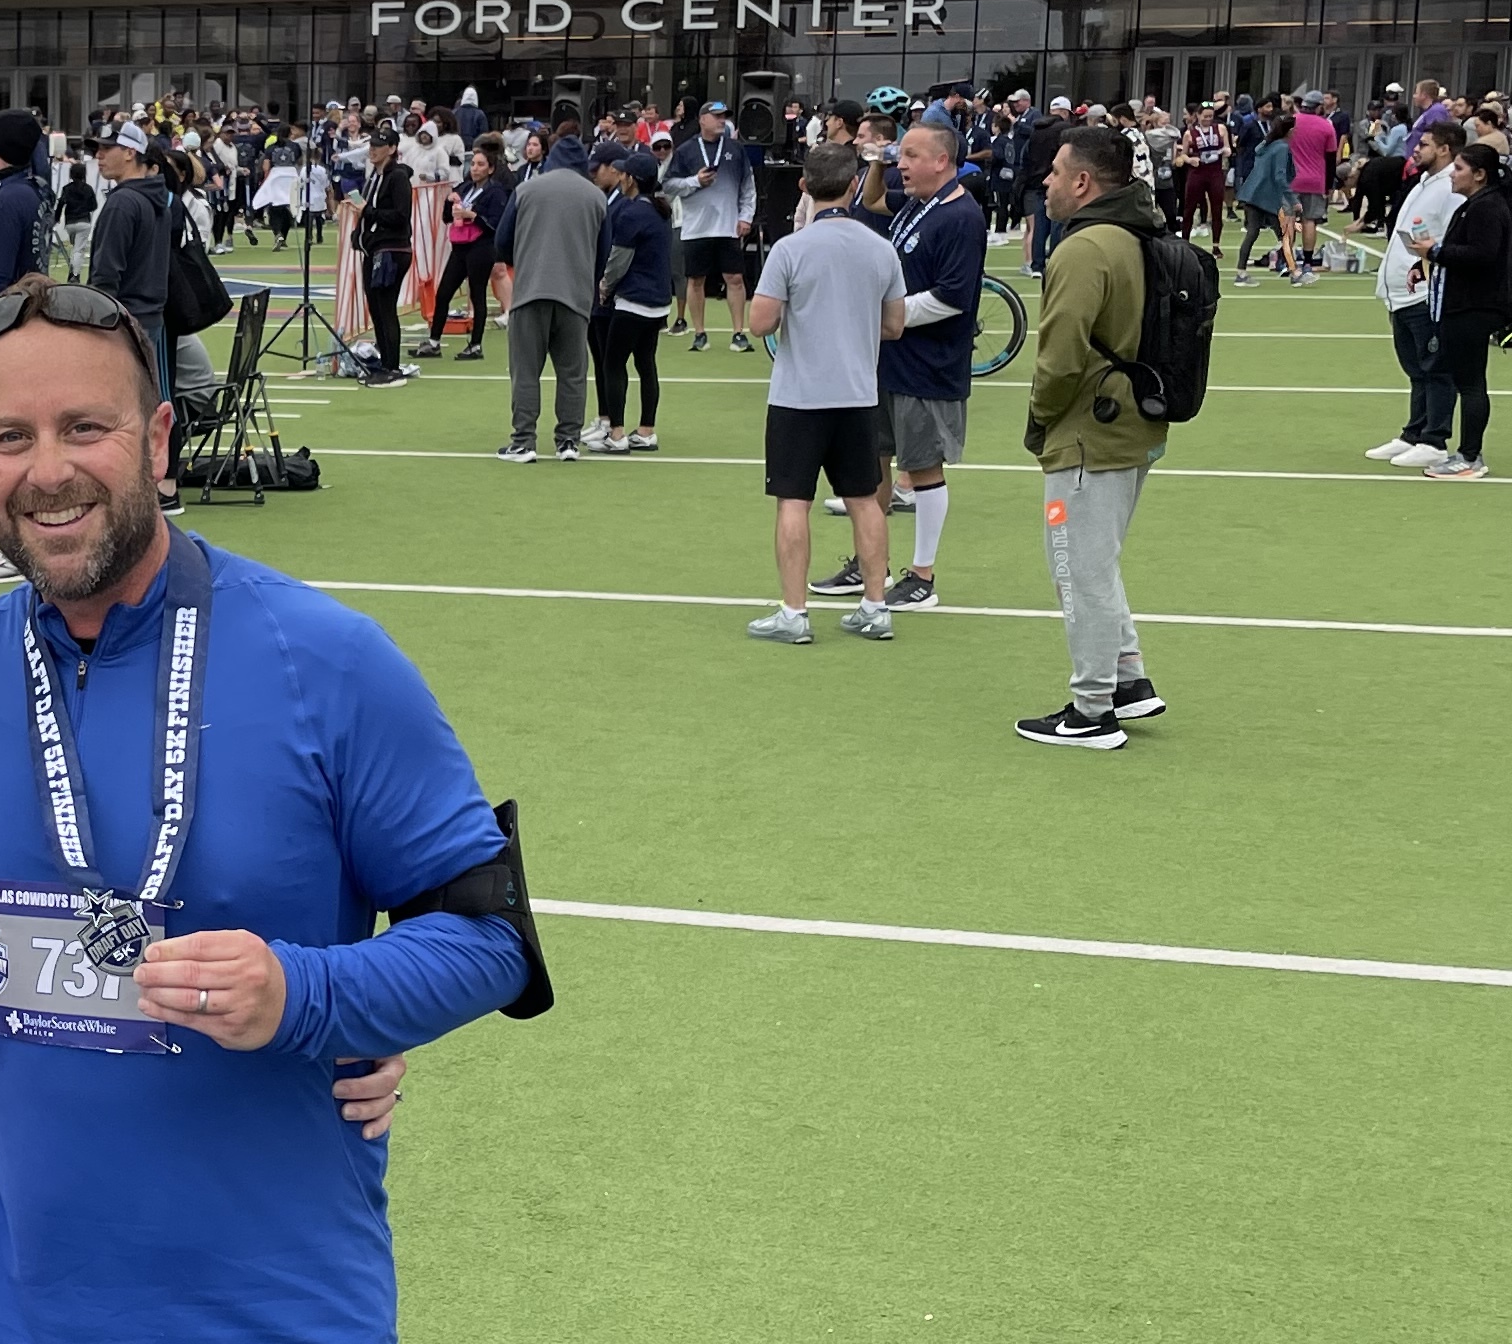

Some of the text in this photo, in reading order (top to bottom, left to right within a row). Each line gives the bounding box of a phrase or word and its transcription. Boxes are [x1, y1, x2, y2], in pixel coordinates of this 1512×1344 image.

[1054, 549, 1071, 577] DO
[23, 616, 51, 695] DRAFT
[35, 694, 61, 743] DAY
[43, 742, 69, 778] 5K
[139, 606, 198, 901] DRAFT DAY 5K FINISHER
[15, 891, 69, 908] COWBOYS
[88, 918, 146, 964] DRAFT DAY
[112, 943, 135, 962] 5K
[23, 1013, 117, 1035] BaylorScott&White
